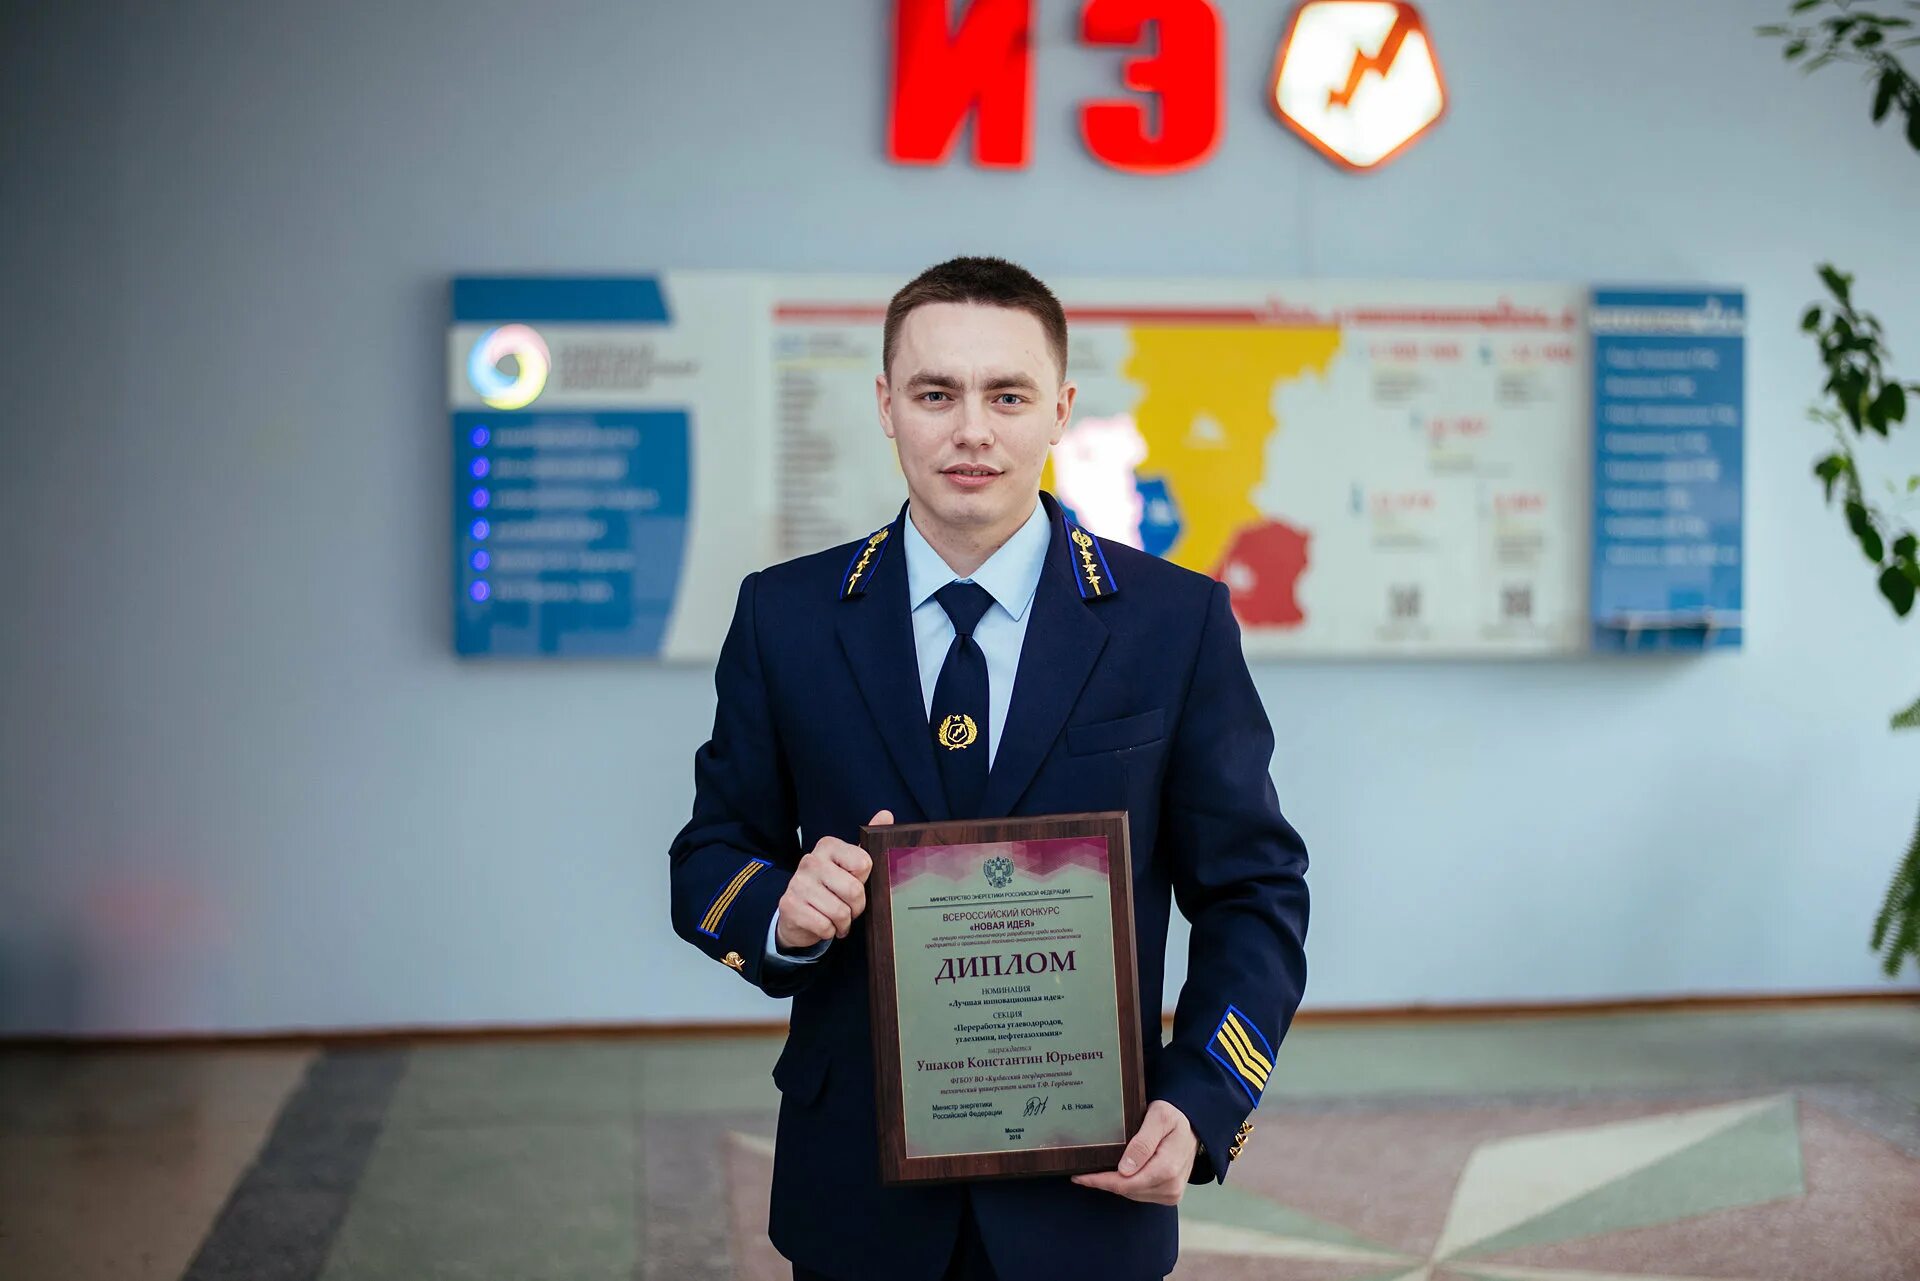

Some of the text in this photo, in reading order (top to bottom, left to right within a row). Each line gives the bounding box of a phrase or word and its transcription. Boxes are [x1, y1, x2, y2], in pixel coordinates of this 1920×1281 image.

[930, 894, 971, 902] МИНИСТЕРСТВО
[1004, 889, 1039, 898] РОССИЙСКОЙ
[1040, 888, 1071, 896] ФЕДЕРАЦИИ
[943, 906, 1060, 922] ВСЕРОССИЙСКИЙ КОНКУРС
[970, 920, 1034, 931] «НОВАЯ ИДЕЯ»
[934, 950, 1076, 984] ДИПЛОМ
[982, 985, 1031, 996] НОМИНАЦИЯ
[949, 998, 982, 1008] «Лучшая
[983, 995, 1042, 1005] инновационная
[993, 1011, 1022, 1020] СЕКЦИЯ
[954, 1019, 1063, 1033] «Переработка углеводородов,
[955, 1030, 1062, 1044] углехимия, нефтегазохимия»
[917, 1051, 1104, 1072] Ушаков Константин Юрьевич
[950, 1076, 973, 1085] ФГБОУ
[975, 1075, 984, 1083] ВО
[932, 1101, 992, 1113] Министр энергетики
[1075, 1103, 1093, 1111] Новак
[933, 1109, 1002, 1120] Российской Федерации
